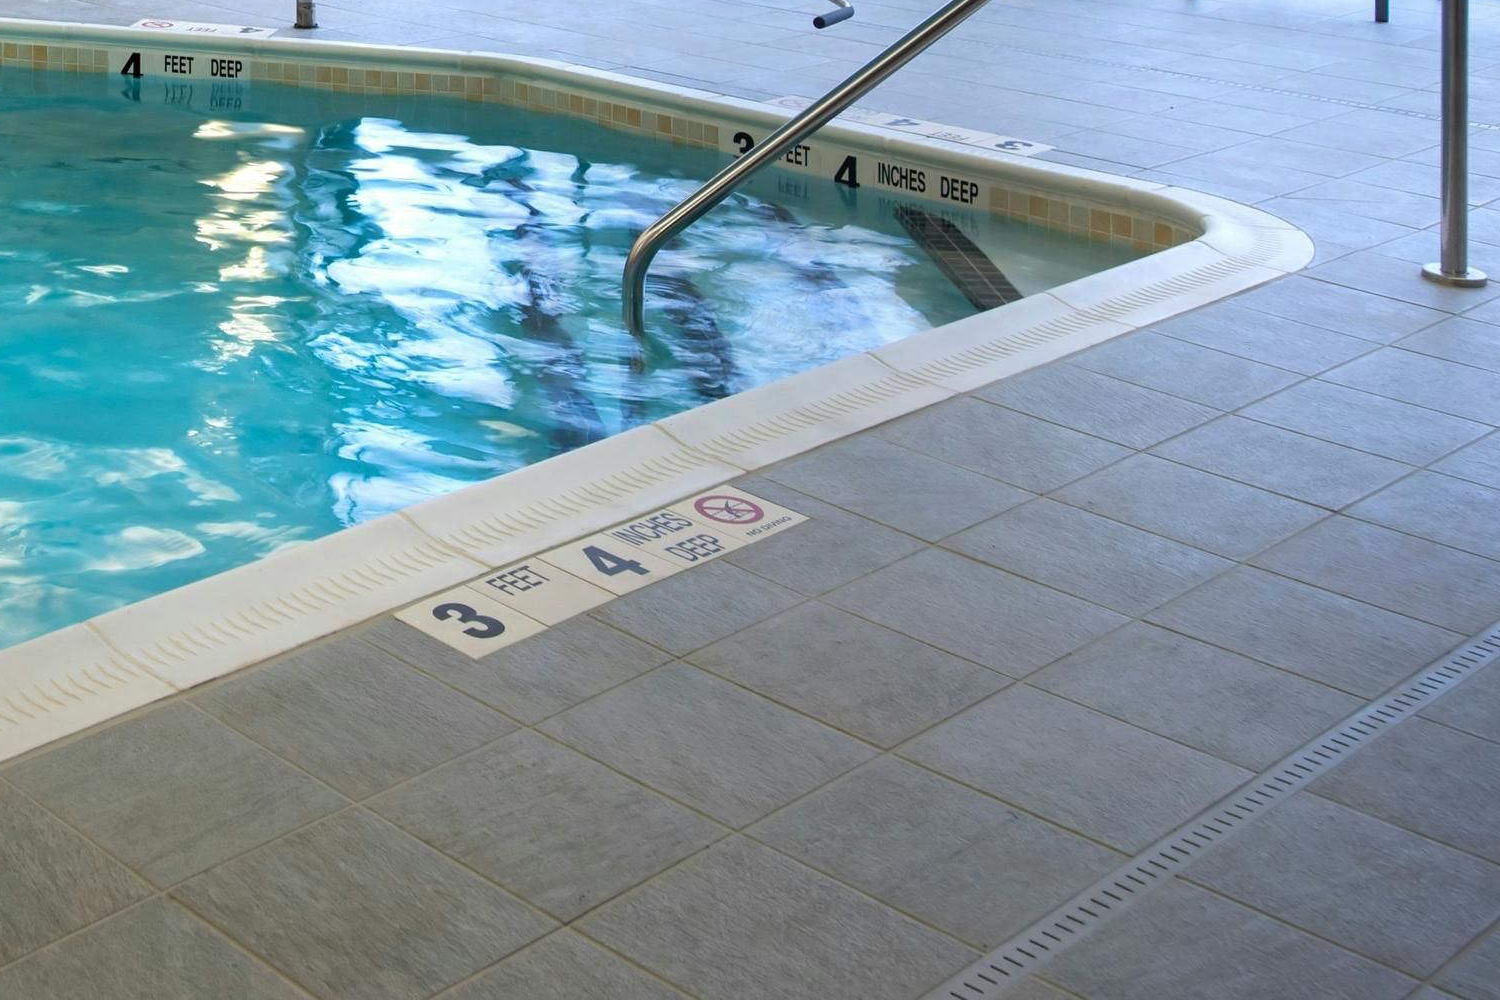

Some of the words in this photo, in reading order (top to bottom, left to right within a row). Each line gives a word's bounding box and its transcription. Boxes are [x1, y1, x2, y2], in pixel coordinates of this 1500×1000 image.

[120, 52, 144, 78] 4
[164, 54, 194, 74] FEET
[210, 59, 243, 78] DEEP
[834, 155, 860, 188] 4
[878, 162, 926, 193] INCHES
[940, 175, 979, 204] DEEP
[611, 512, 693, 547] INCHES
[746, 527, 763, 537] NO
[761, 515, 792, 531] DIVING
[582, 545, 651, 577] 4
[664, 534, 726, 562] DEEP
[486, 564, 551, 597] FEET
[432, 602, 505, 639] 3
